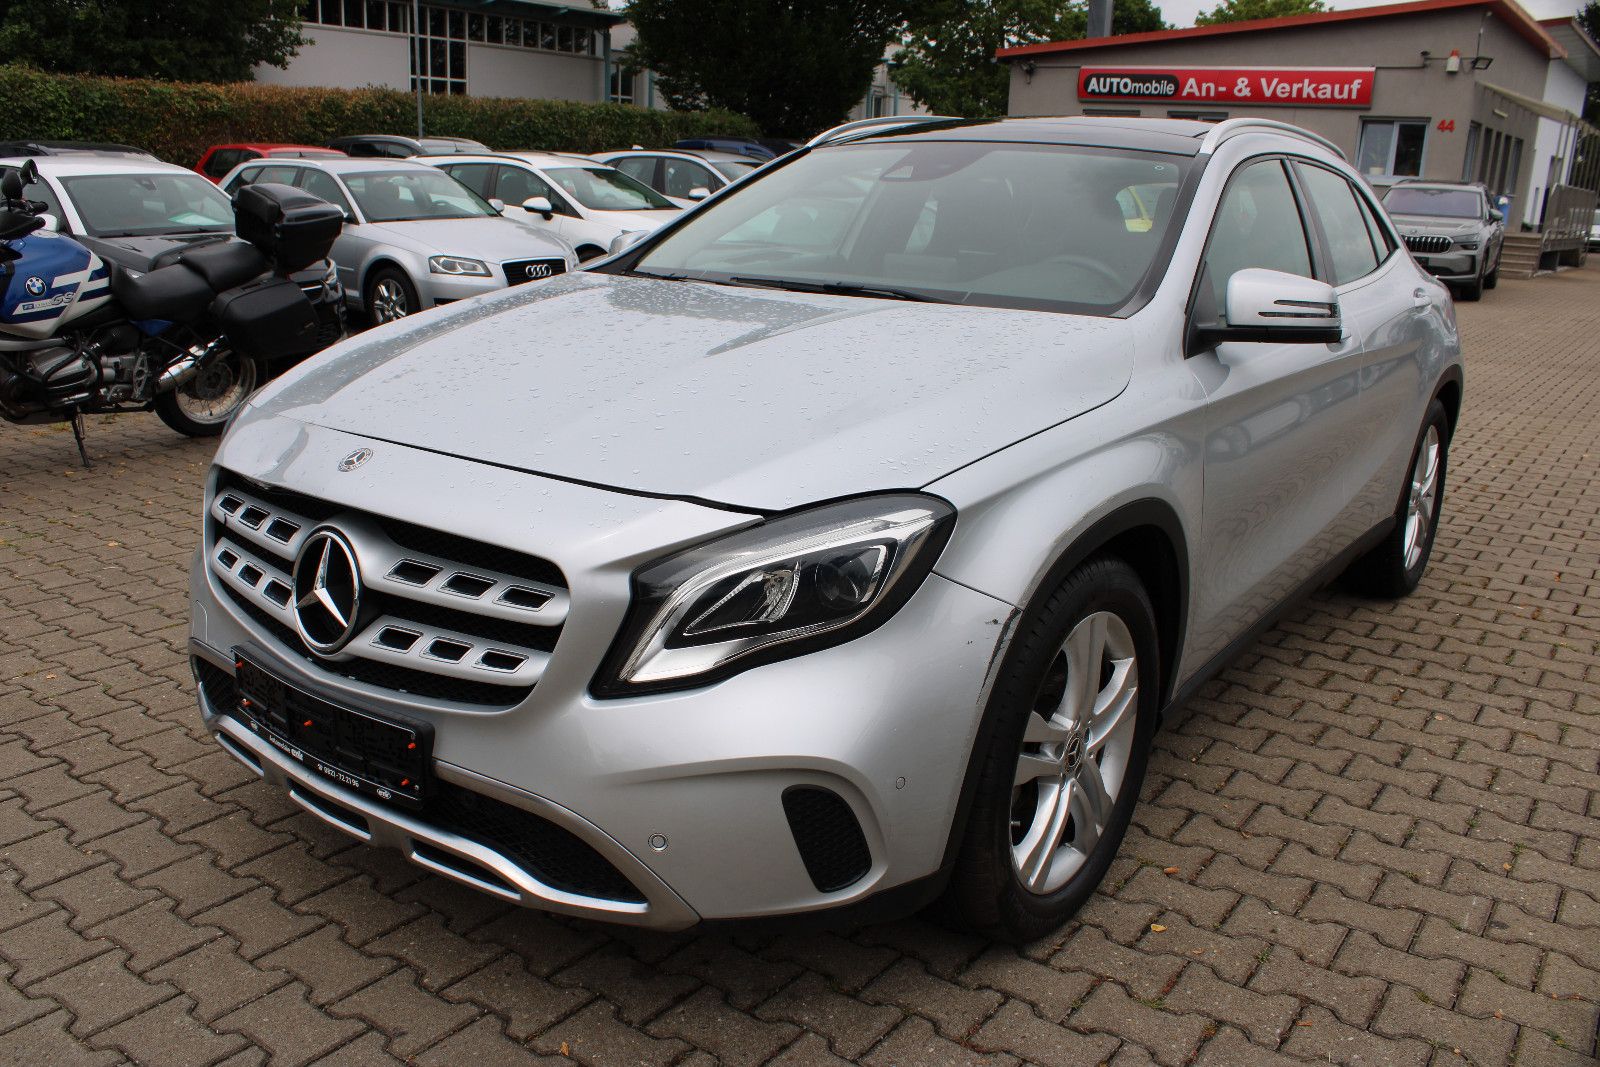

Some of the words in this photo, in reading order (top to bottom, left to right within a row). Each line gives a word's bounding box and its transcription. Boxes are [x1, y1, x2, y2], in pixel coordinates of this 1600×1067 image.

[1086, 77, 1175, 96] AUTOmobile
[1181, 77, 1226, 97] An-
[1233, 77, 1252, 97] &
[1260, 77, 1363, 100] Verkauf
[1437, 119, 1455, 132] 44
